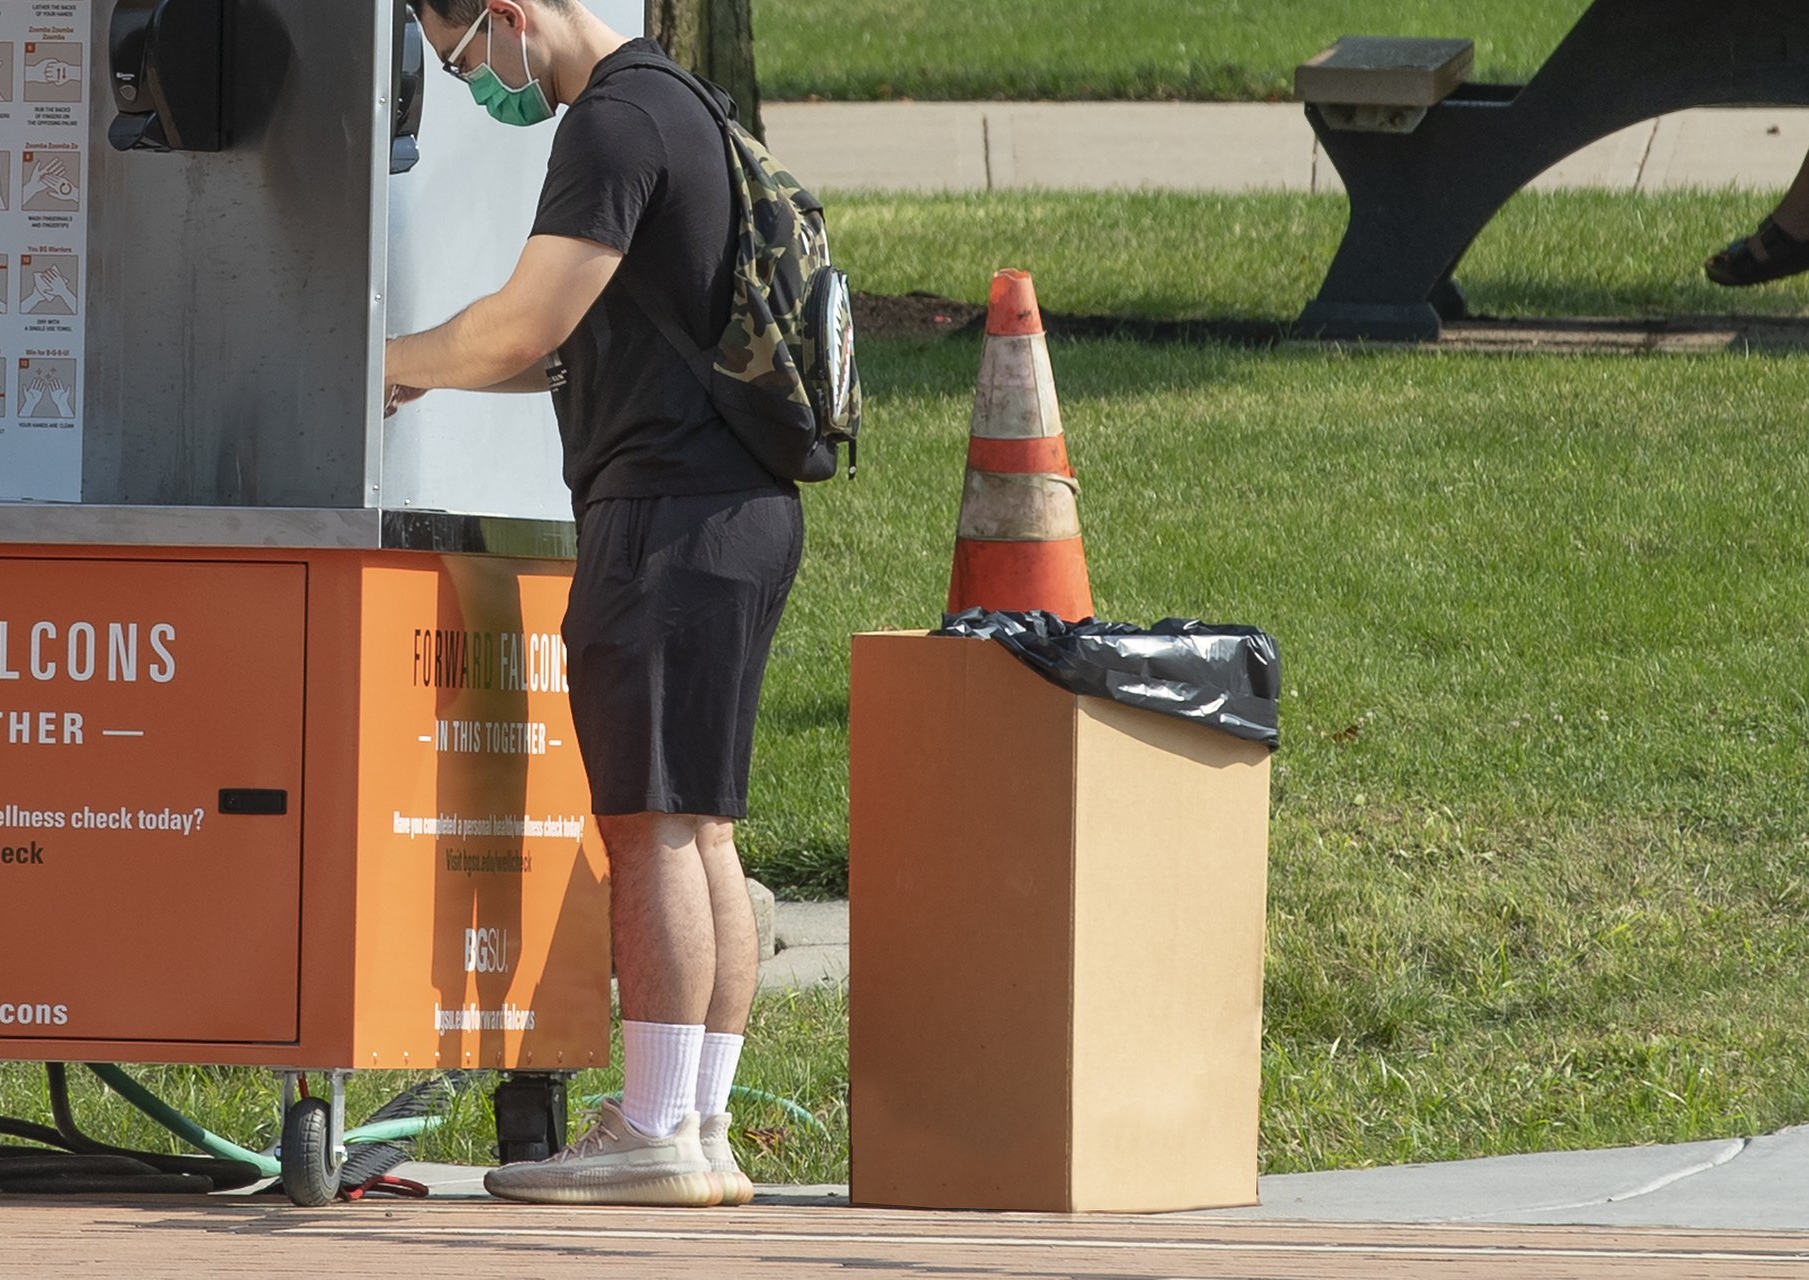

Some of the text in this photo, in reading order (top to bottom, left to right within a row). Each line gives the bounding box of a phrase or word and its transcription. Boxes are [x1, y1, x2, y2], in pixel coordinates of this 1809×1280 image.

[414, 629, 492, 690] FORWARD
[435, 720, 546, 755] IN THIS TOGETHER
[71, 806, 133, 831] check
[137, 808, 204, 835] today?
